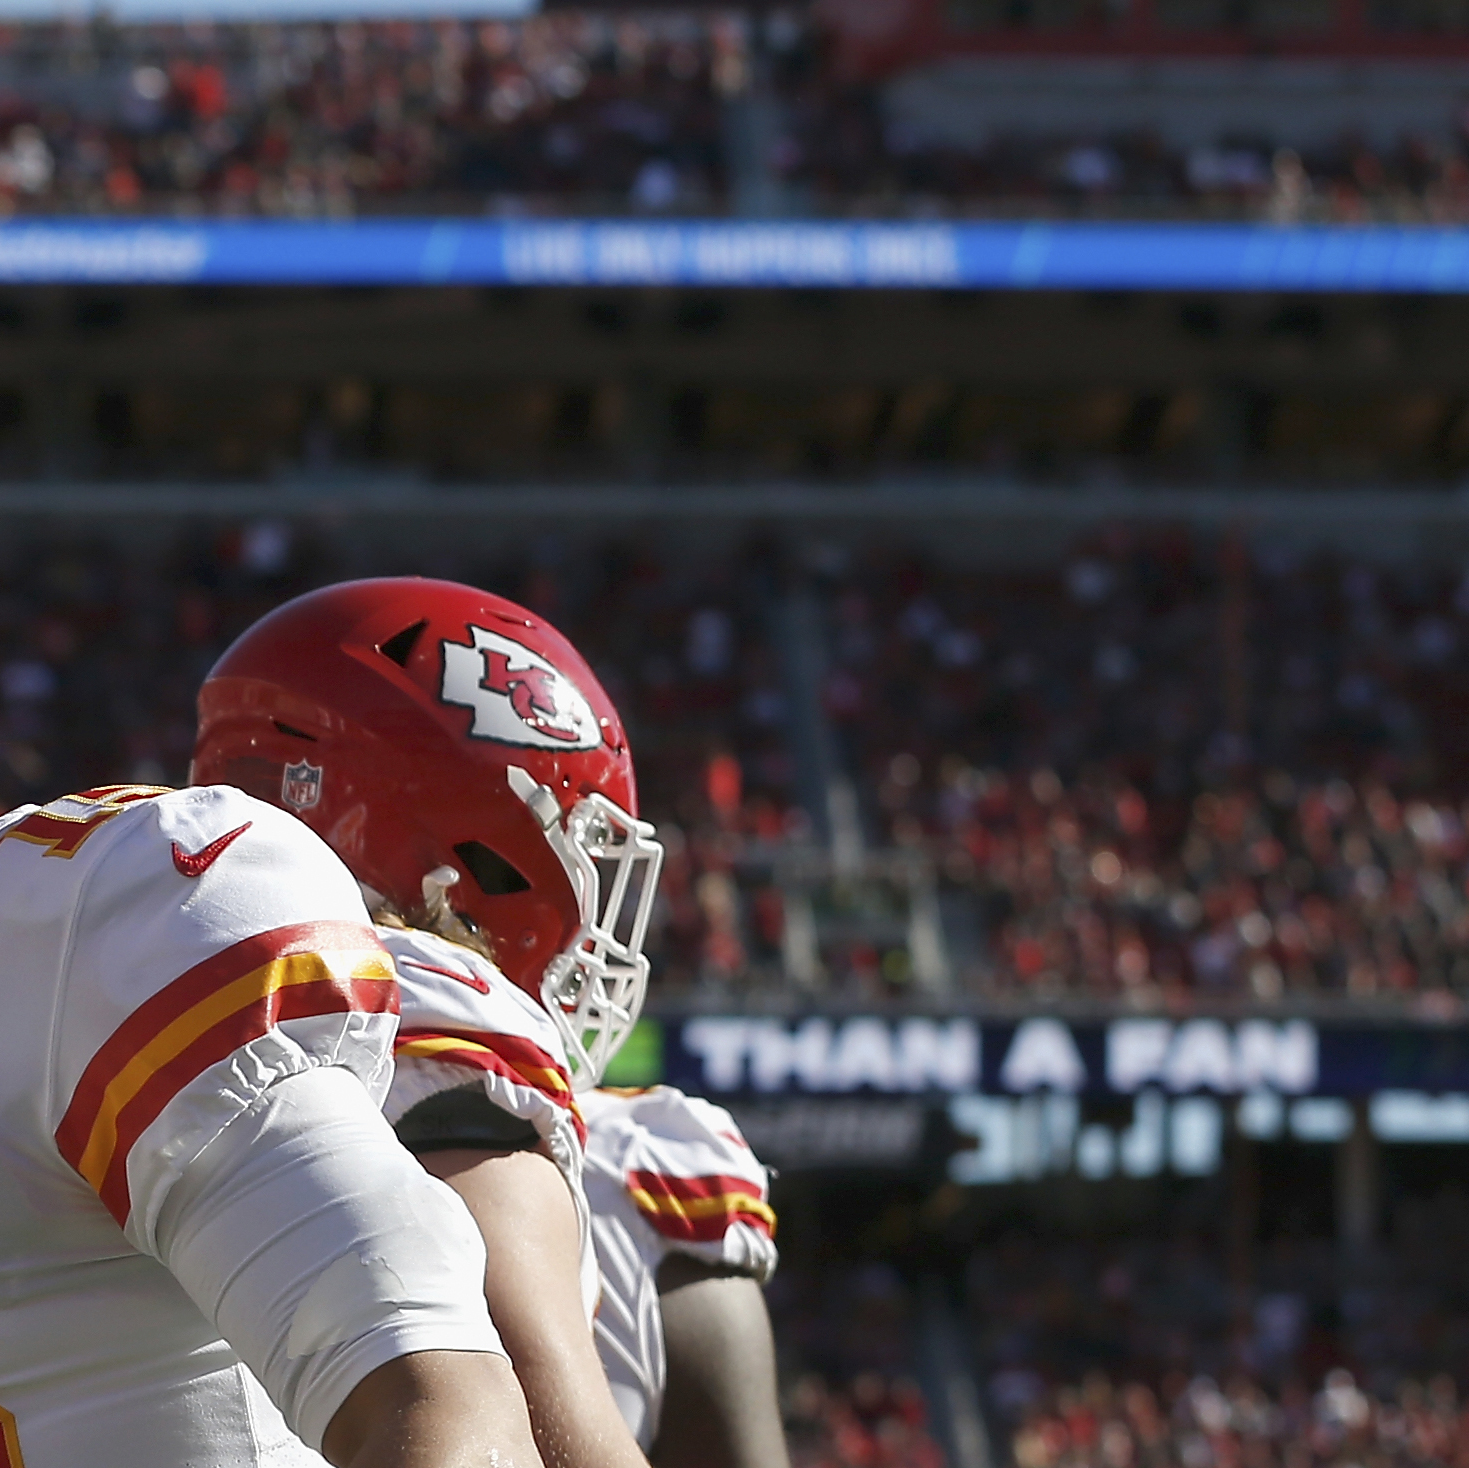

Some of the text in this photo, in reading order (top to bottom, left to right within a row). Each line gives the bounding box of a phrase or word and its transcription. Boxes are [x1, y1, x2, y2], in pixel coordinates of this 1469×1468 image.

[683, 1015, 1323, 1095] THAN A FAN
